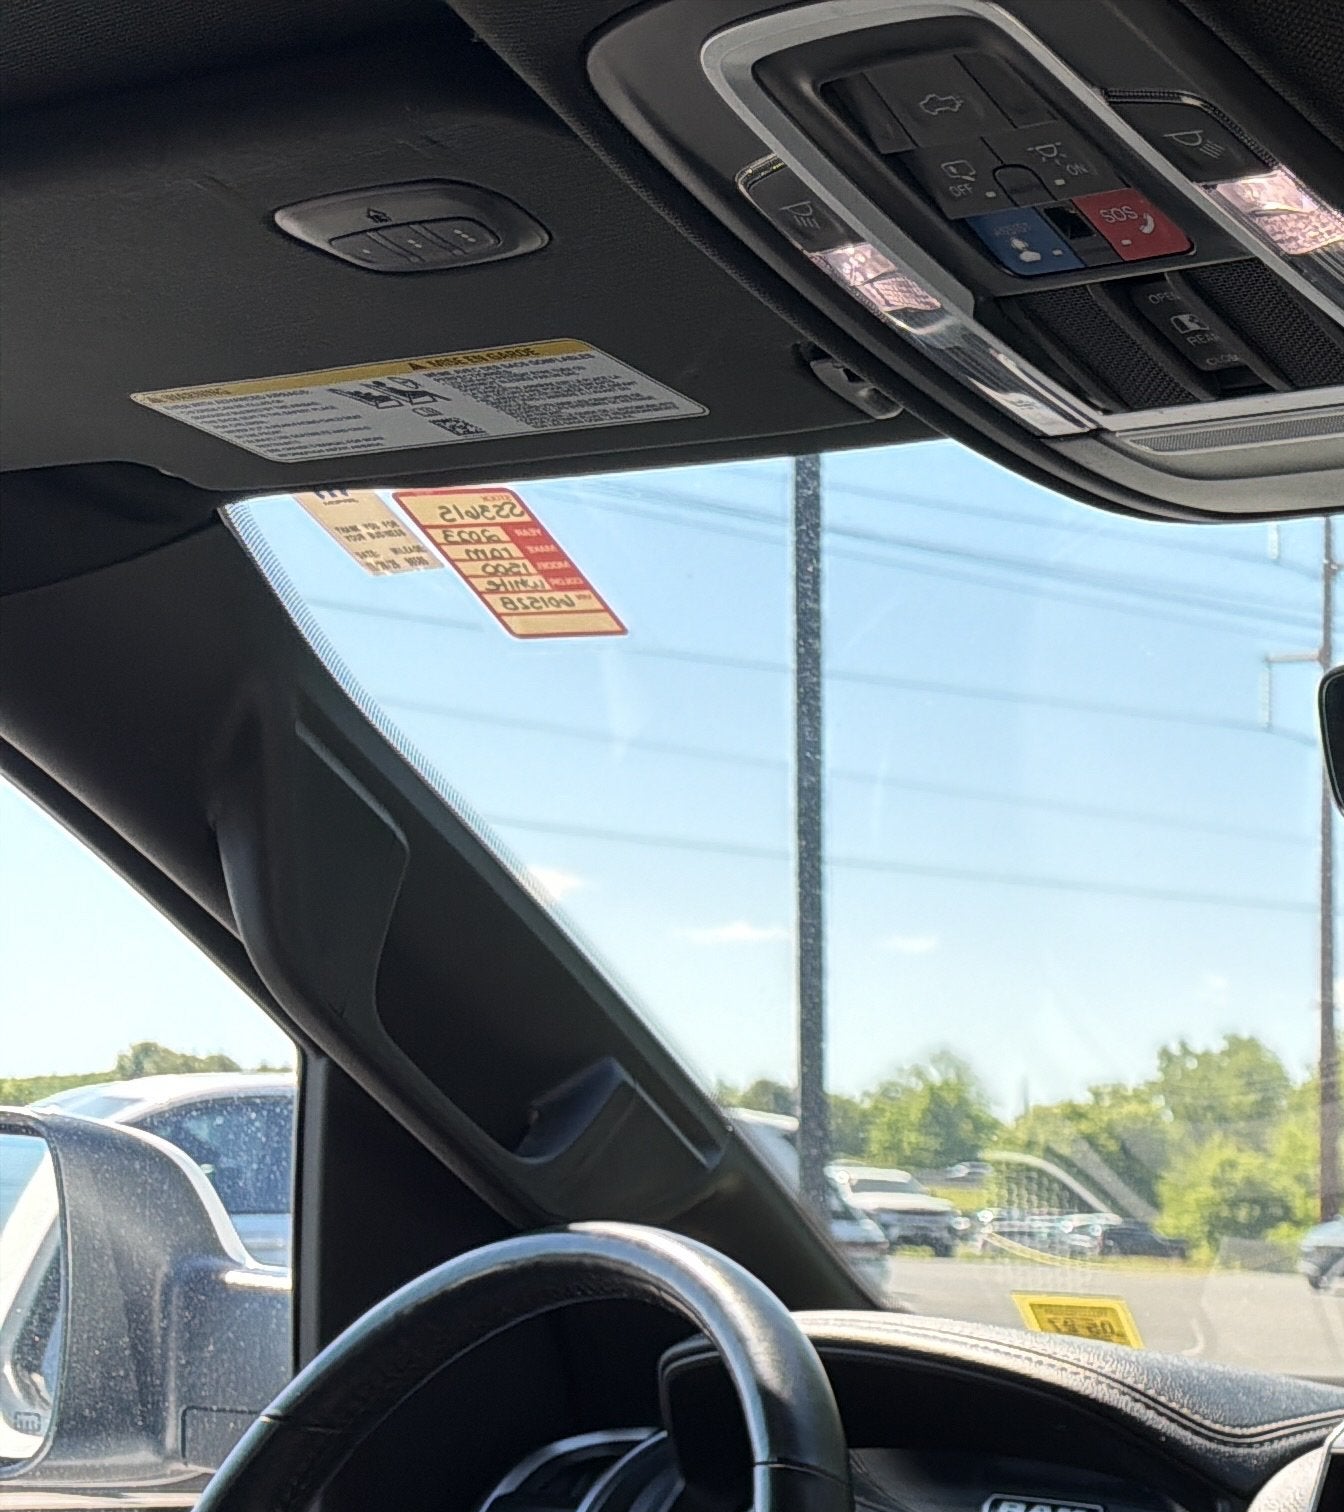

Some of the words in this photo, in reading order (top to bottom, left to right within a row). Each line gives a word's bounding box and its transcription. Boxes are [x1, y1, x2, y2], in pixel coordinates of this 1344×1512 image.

[1066, 163, 1088, 175] ON
[950, 183, 974, 197] OFF
[1100, 206, 1139, 224] SOS
[488, 348, 539, 361] GARDE
